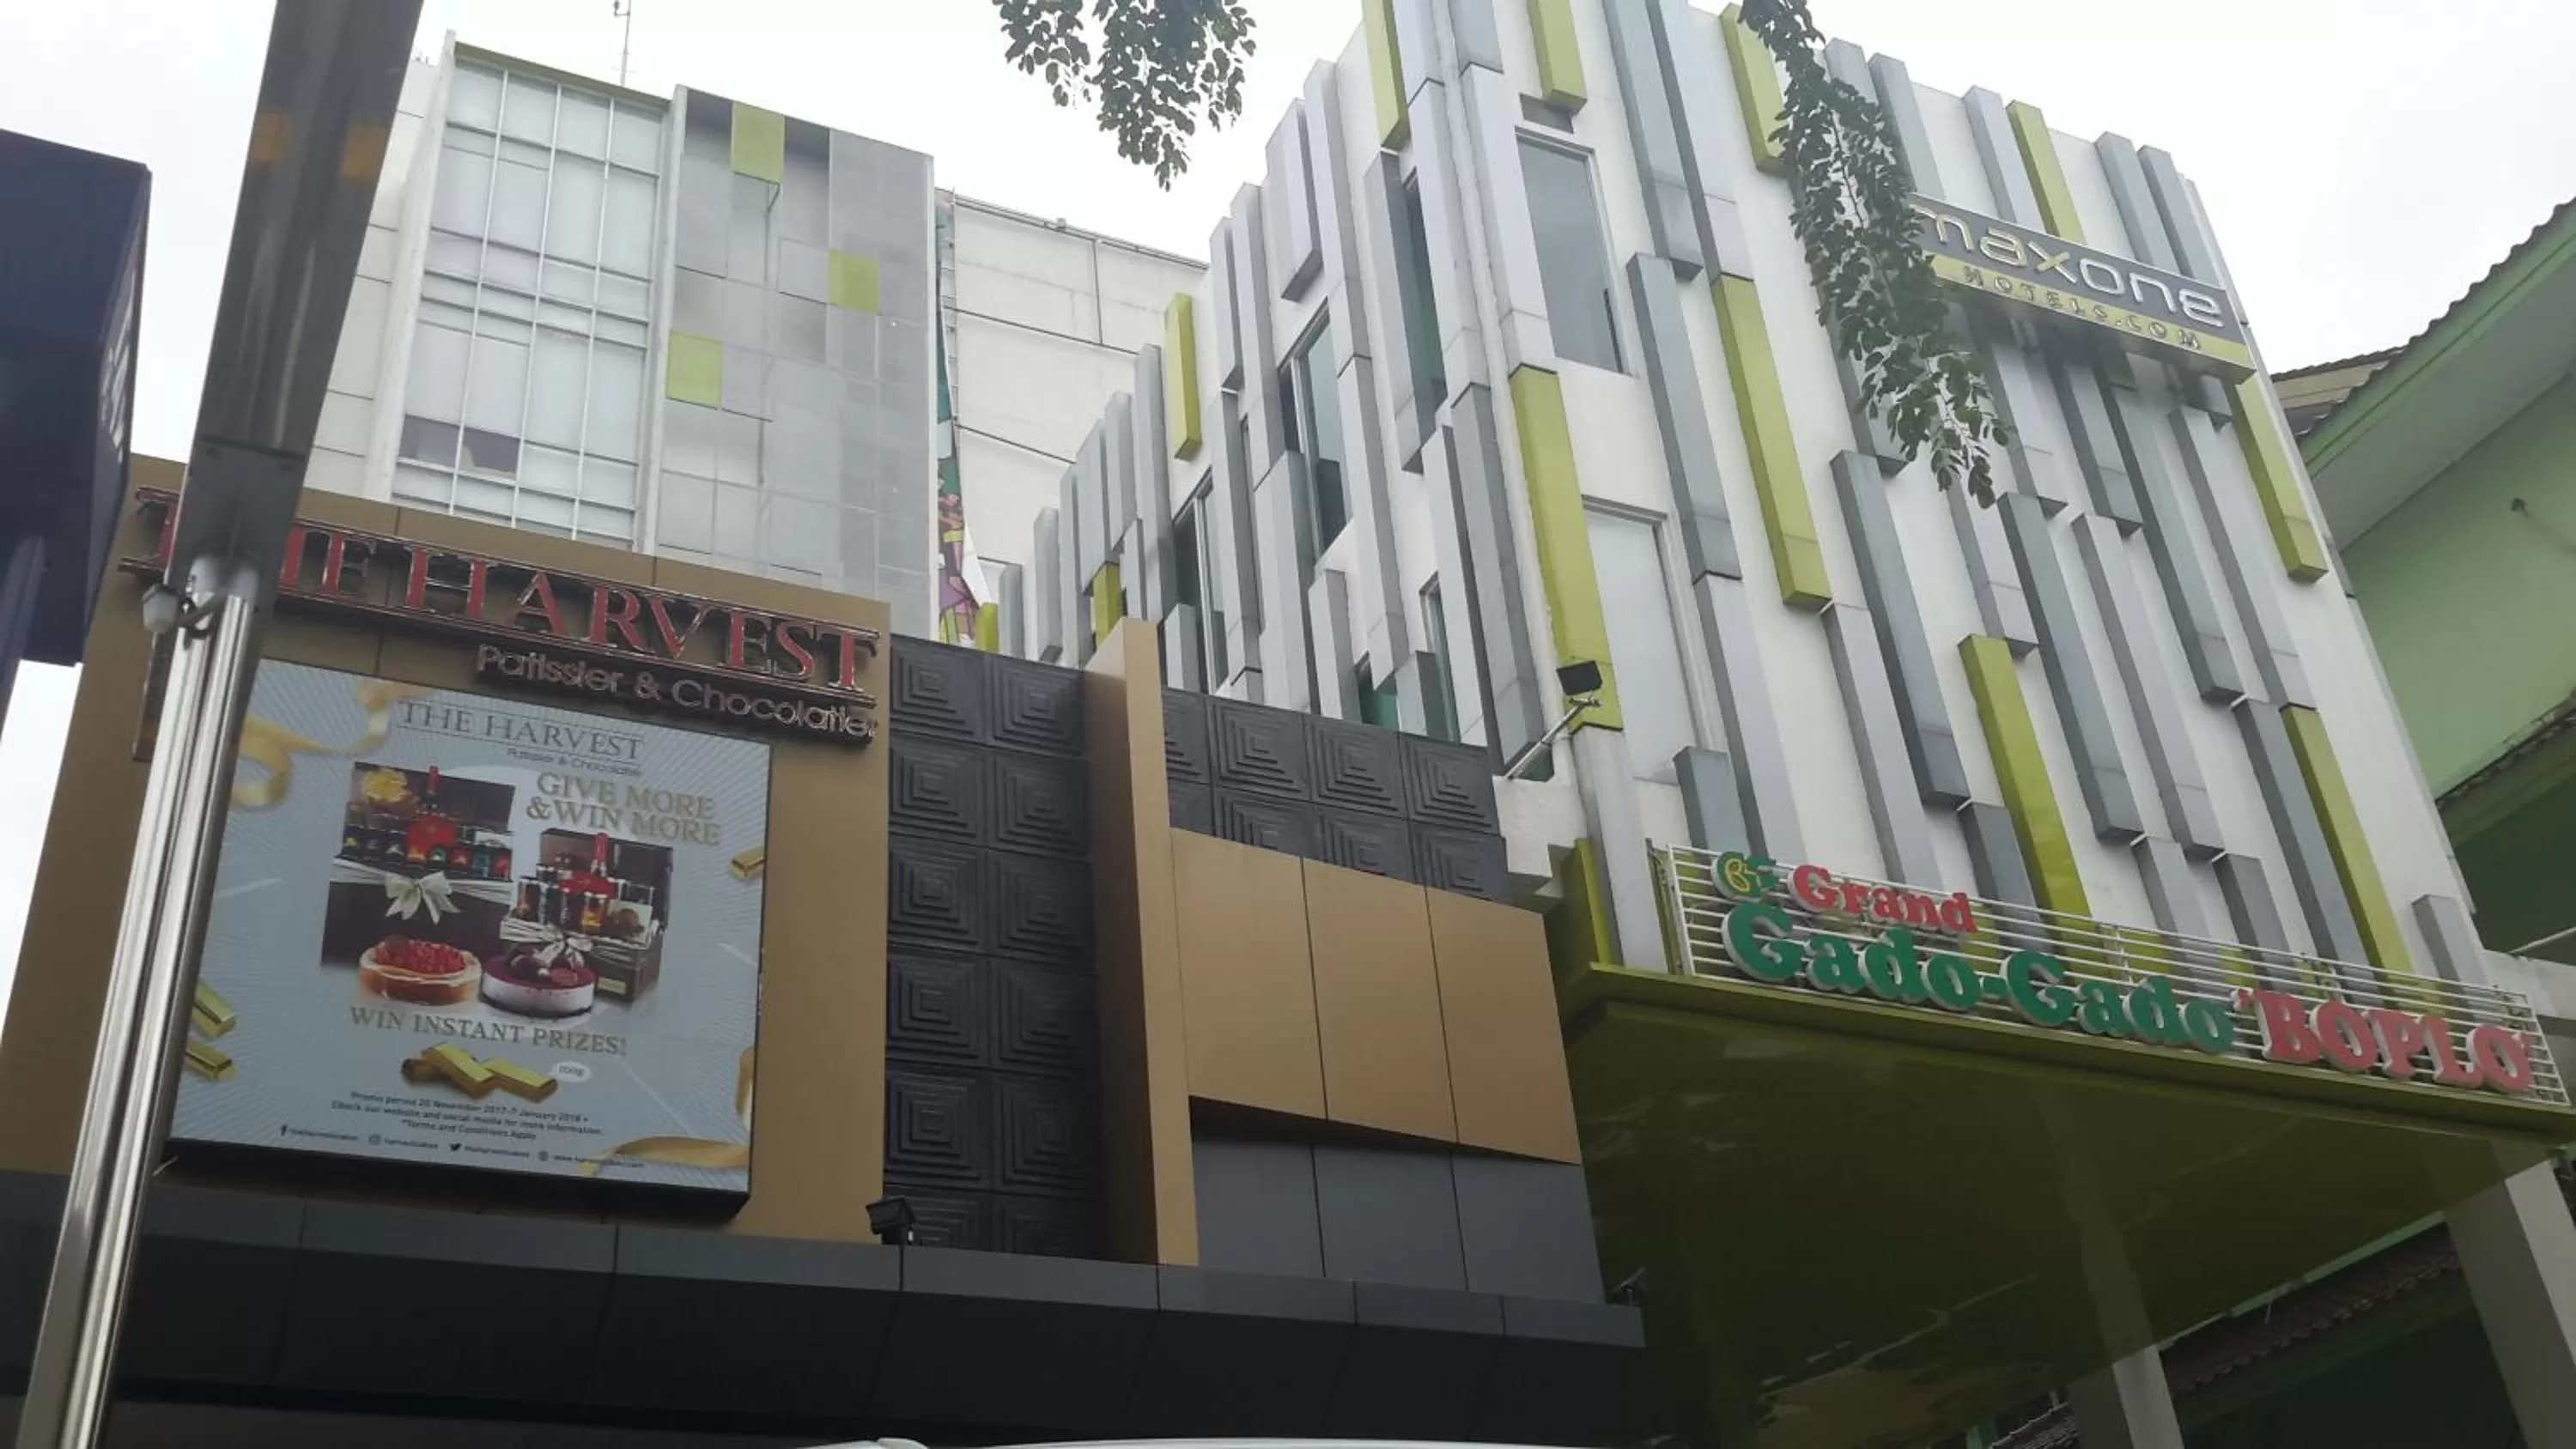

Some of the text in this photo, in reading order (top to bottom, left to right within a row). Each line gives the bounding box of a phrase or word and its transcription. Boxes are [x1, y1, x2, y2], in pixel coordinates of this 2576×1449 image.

[401, 547, 880, 692] HARVEST
[476, 643, 878, 740] Patissier & Chocolatier
[402, 700, 646, 760] THE HARVEST
[526, 796, 722, 846] &WIN MORE
[537, 773, 715, 822] GIVE MORE
[1789, 864, 1978, 934] Grand
[1721, 903, 2233, 1055] Gado-Gado
[349, 1005, 629, 1057] WIN INSTANT PRIZES!
[422, 1111, 440, 1119] and
[473, 1115, 502, 1125] media
[433, 1100, 481, 1111] November
